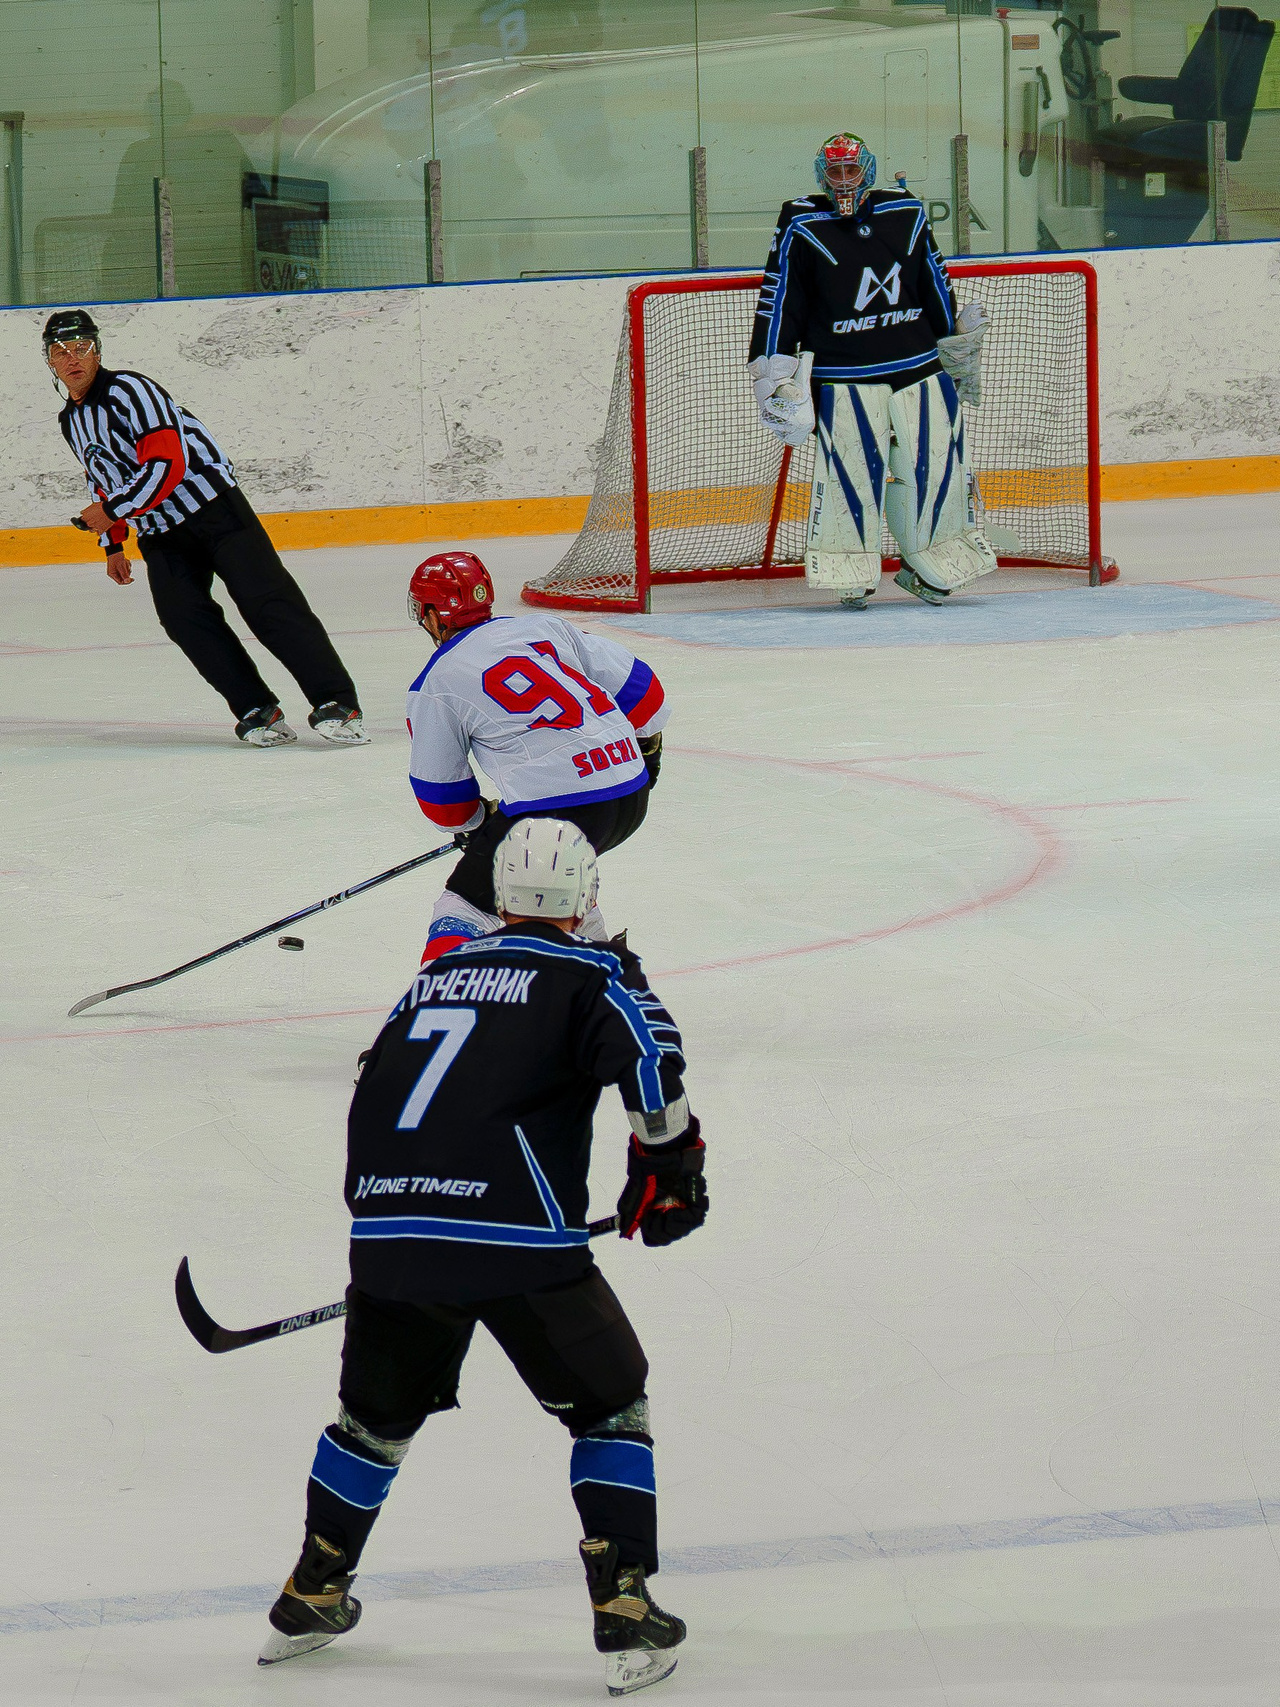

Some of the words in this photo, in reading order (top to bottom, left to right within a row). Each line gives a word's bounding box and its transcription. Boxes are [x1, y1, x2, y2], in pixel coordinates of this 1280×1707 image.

[832, 315, 878, 334] ONE
[810, 480, 825, 542] TRUE
[481, 639, 618, 730] 91
[571, 737, 639, 778] SOCHI
[535, 893, 544, 908] 7
[396, 1008, 477, 1131] 7
[370, 1177, 409, 1195] ONE
[411, 1176, 489, 1198] TIMER
[278, 1312, 313, 1335] ONE
